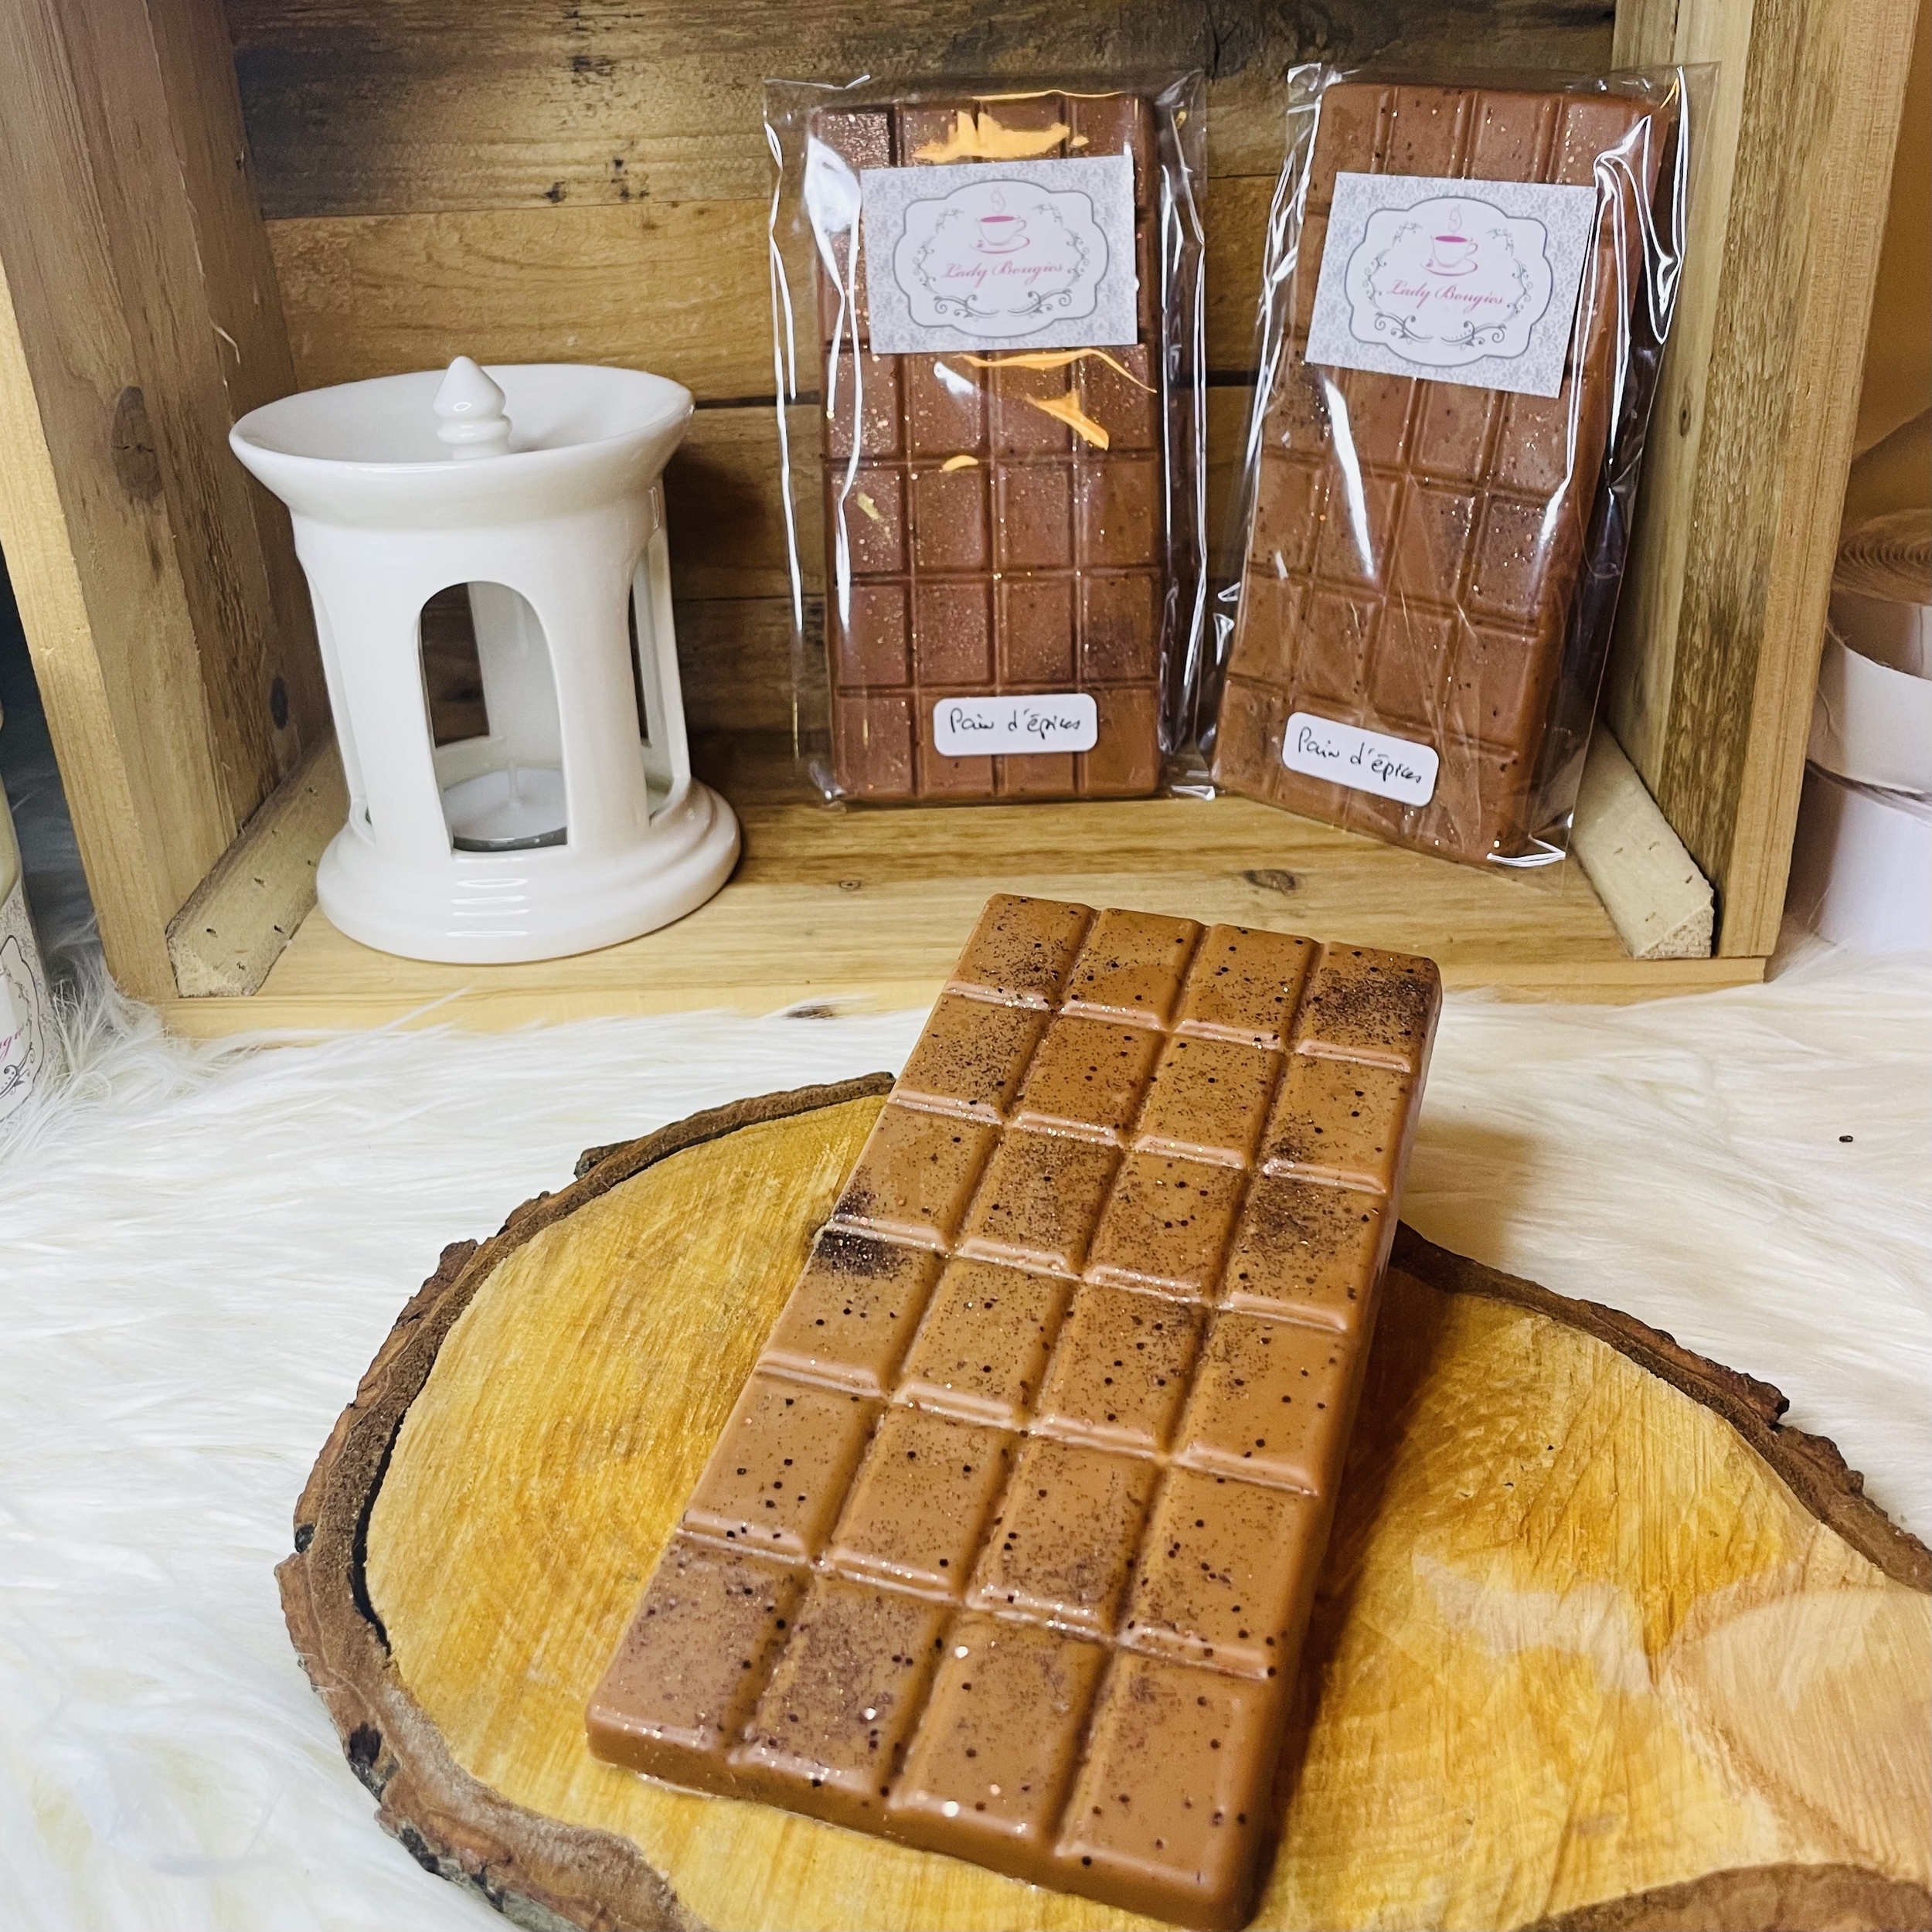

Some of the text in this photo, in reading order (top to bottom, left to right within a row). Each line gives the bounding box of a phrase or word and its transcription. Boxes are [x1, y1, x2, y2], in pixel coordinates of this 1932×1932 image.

[941, 262, 987, 288] Lady
[1388, 279, 1430, 309] Lady
[950, 707, 995, 733] Pain
[1298, 726, 1340, 758] Pain
